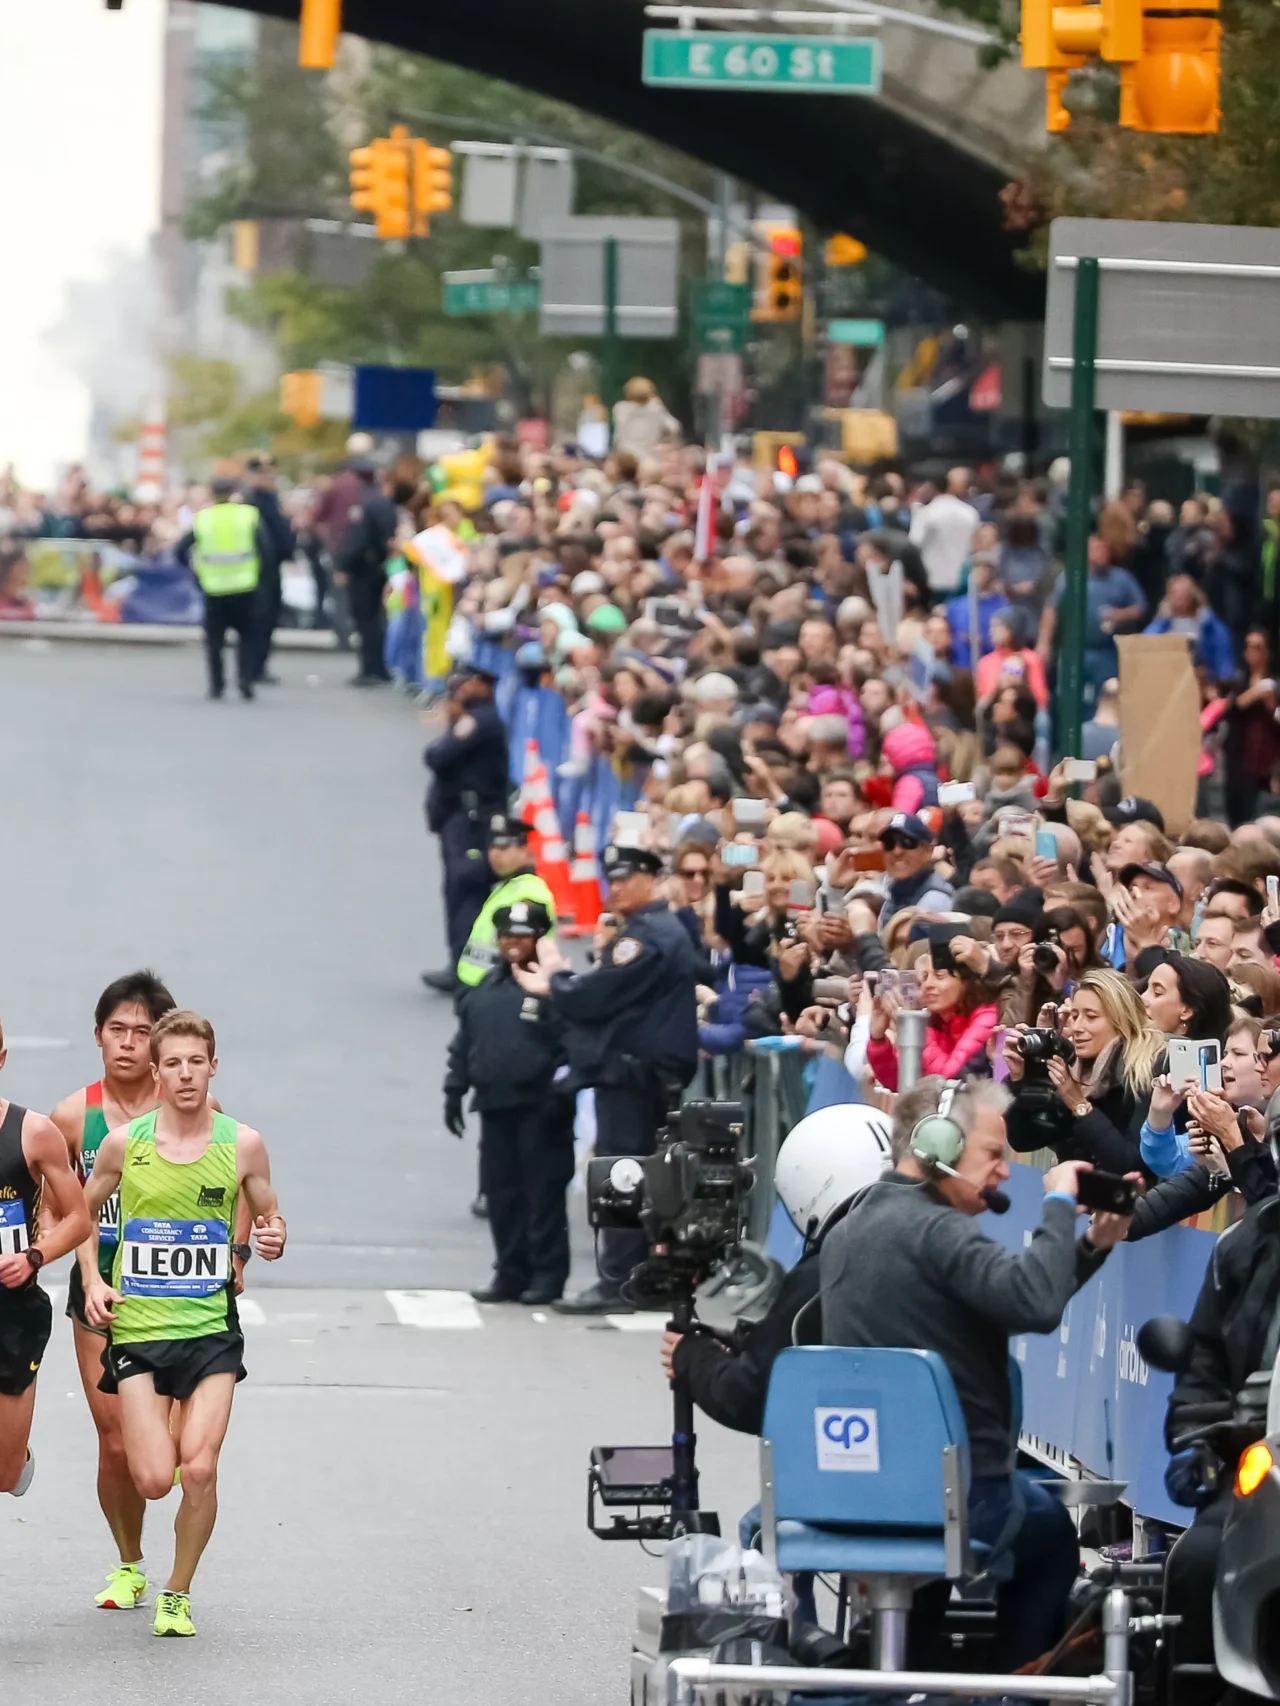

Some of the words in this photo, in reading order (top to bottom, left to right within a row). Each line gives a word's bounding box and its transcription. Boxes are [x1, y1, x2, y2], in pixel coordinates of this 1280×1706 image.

[688, 42, 713, 75] E
[724, 44, 779, 78] 60
[789, 47, 836, 81] St
[153, 1221, 172, 1229] TATA
[140, 1227, 183, 1236] CONSULTANCY
[148, 1234, 176, 1242] SERVICES
[131, 1246, 217, 1277] LEON
